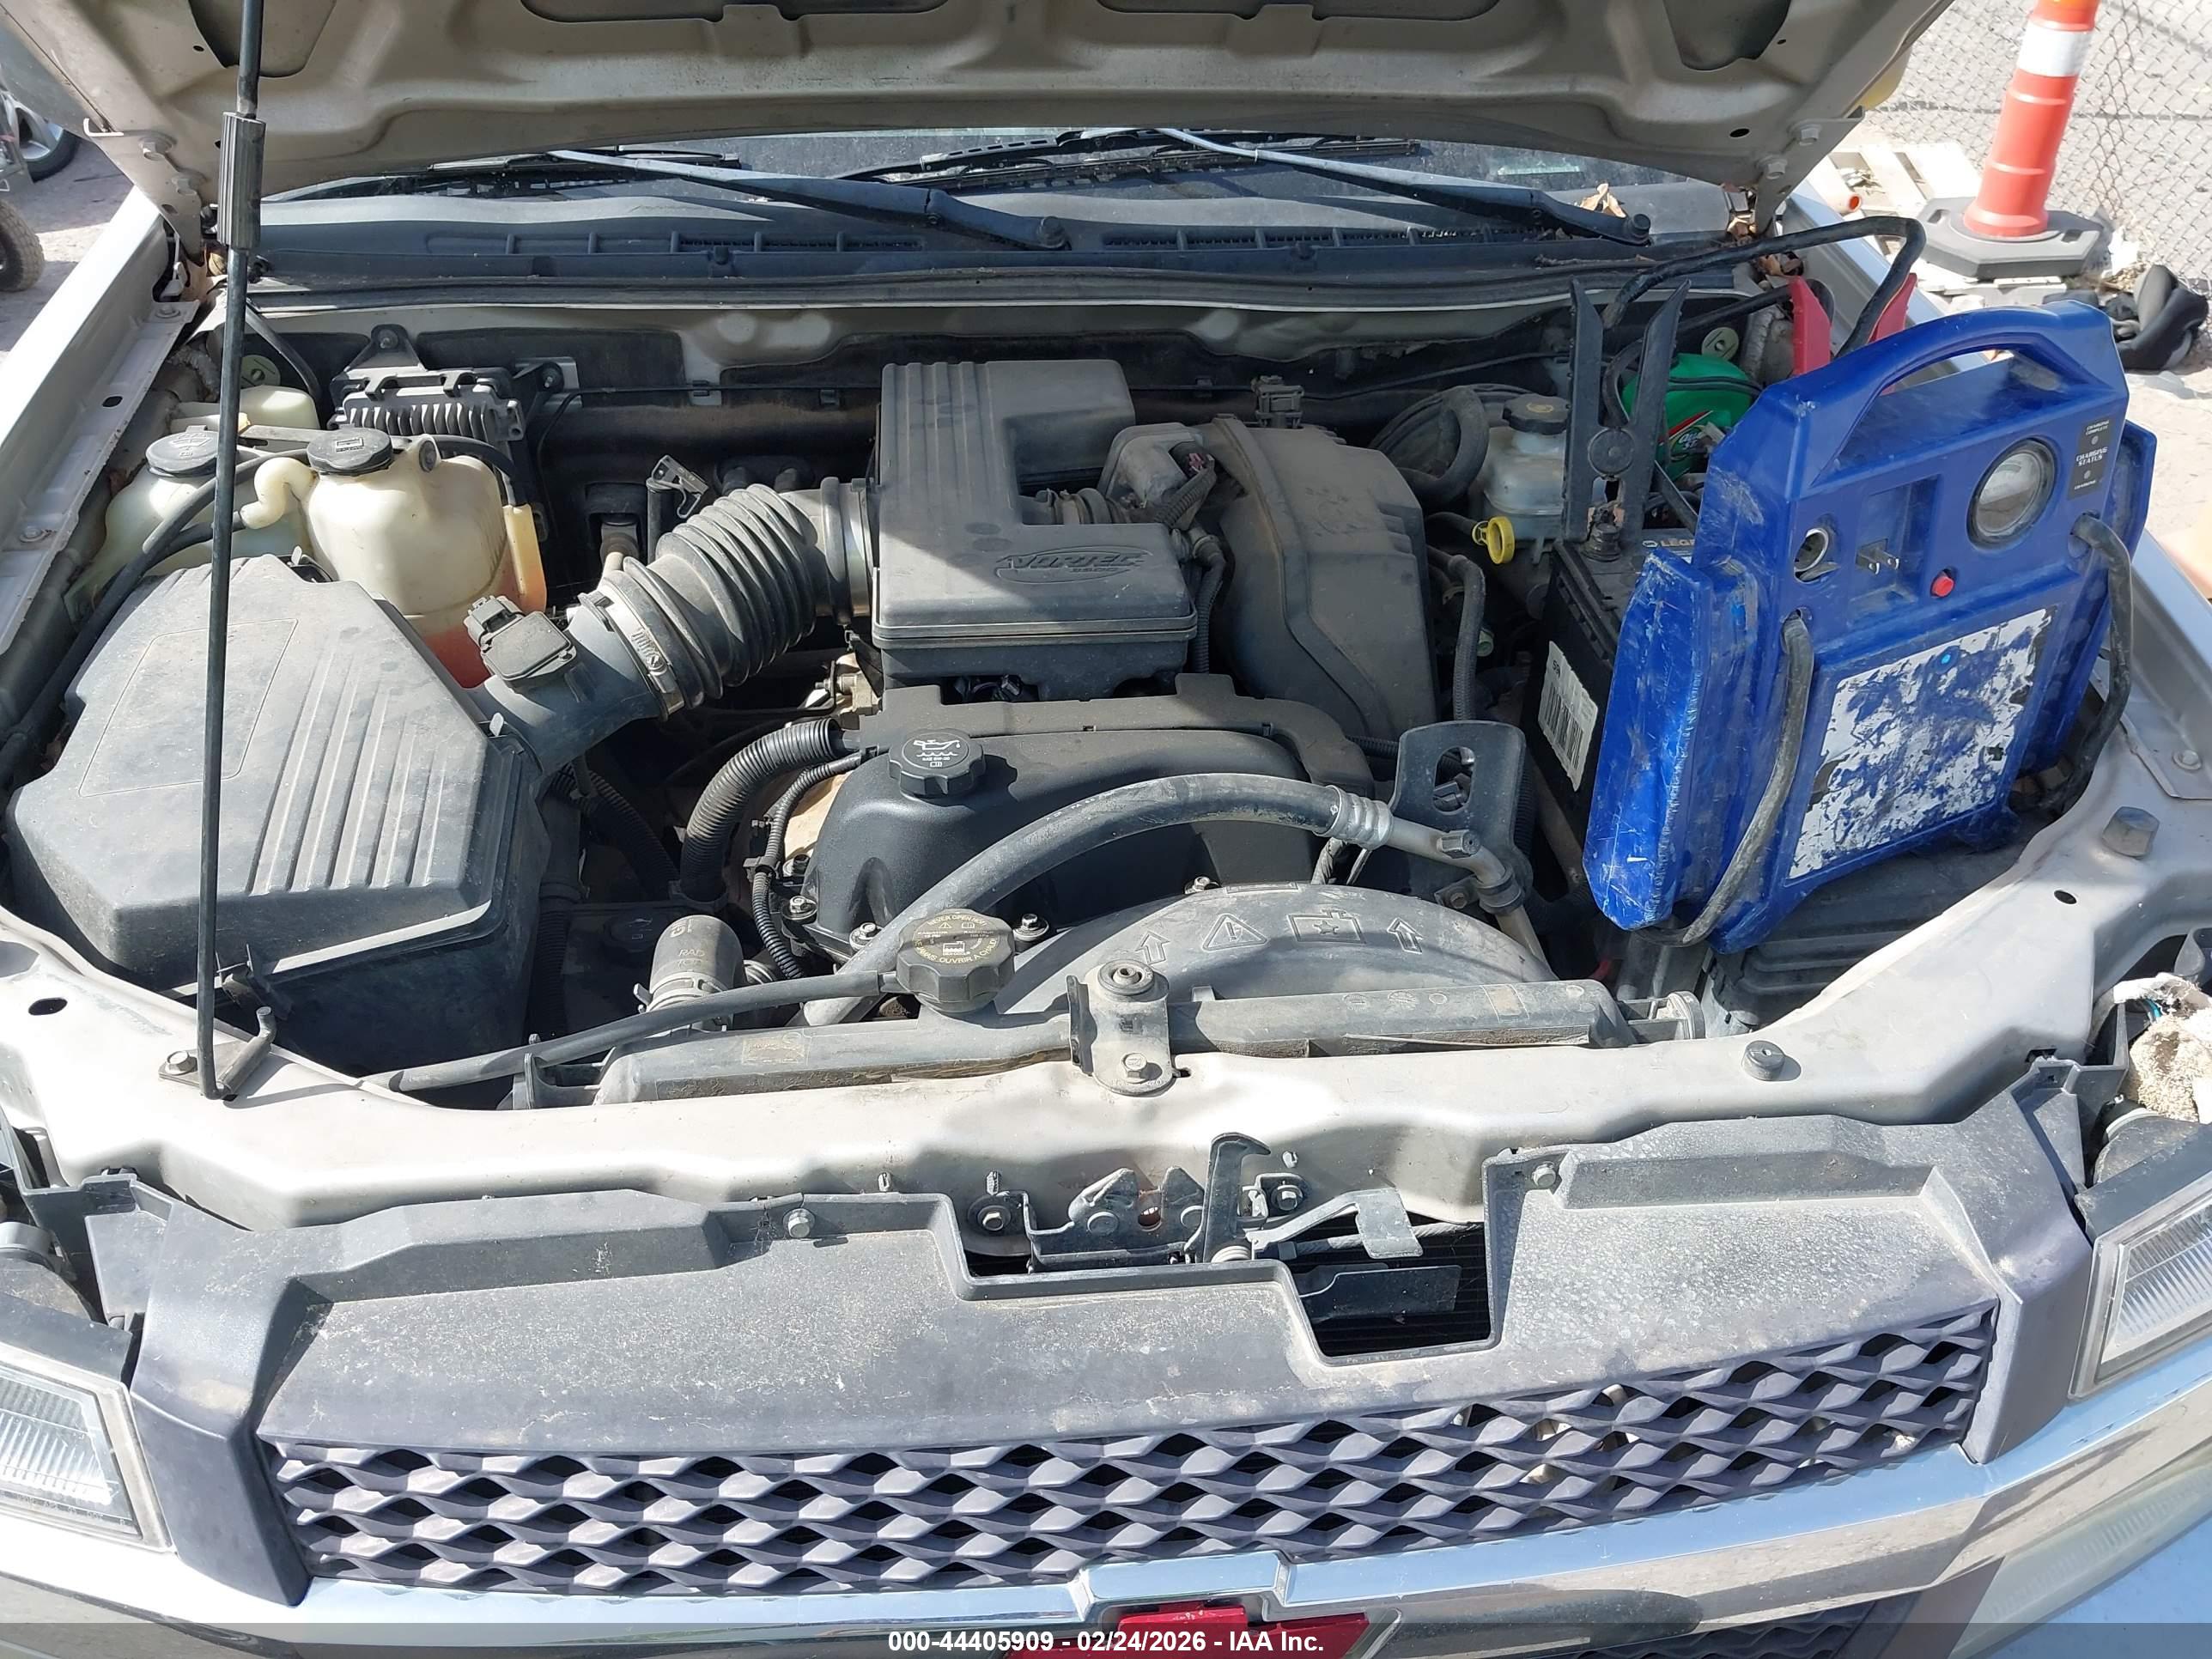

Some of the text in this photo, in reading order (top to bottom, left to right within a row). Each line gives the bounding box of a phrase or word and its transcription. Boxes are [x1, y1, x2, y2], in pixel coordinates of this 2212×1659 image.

[2076, 447, 2108, 462] CHARGING
[2078, 454, 2103, 466] STATUS
[927, 915, 951, 926] NEVER
